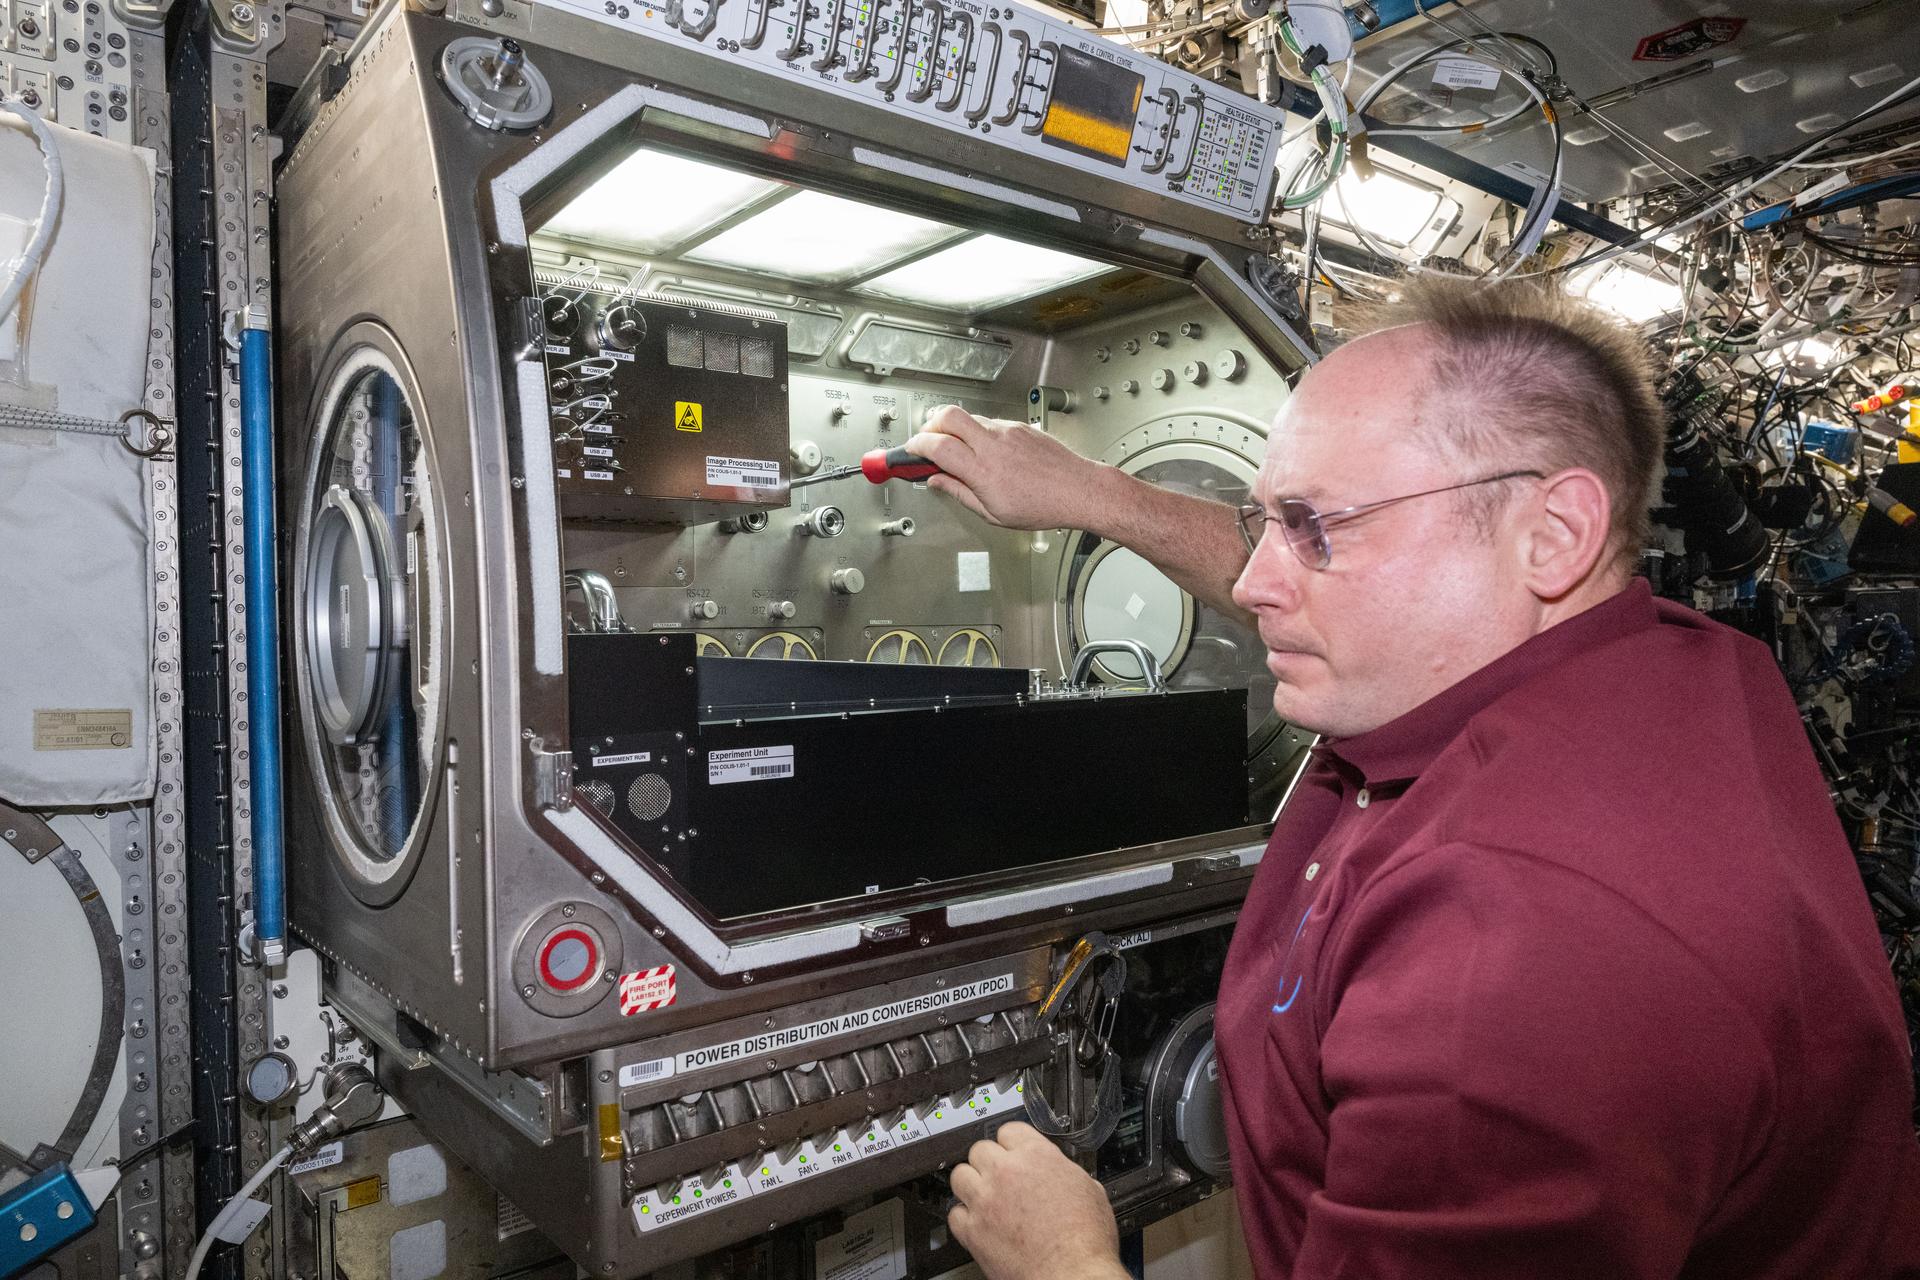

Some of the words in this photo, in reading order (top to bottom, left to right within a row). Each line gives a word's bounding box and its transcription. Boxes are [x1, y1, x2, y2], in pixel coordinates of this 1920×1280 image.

[458, 13, 480, 25] UNLOCK
[503, 12, 517, 21] LOCK
[21, 43, 40, 53] Down
[1079, 42, 1089, 51] INFO
[1096, 48, 1115, 60] CONTROL
[1117, 56, 1133, 69] CENTRE
[786, 62, 801, 71] OUTLET
[820, 73, 834, 82] OUTLET
[1245, 115, 1261, 126] STATUS
[707, 457, 727, 467] Image
[728, 459, 763, 470] Processing
[597, 756, 633, 764] EXPERIMENT
[710, 750, 752, 762] Experiment
[753, 748, 769, 757] Unit
[630, 985, 646, 993] FIRE
[648, 980, 667, 990] PORT
[685, 1043, 740, 1068] POWER
[744, 1020, 839, 1055] DISTRIBUTION
[842, 1012, 869, 1031] AND
[872, 991, 950, 1023] CONVERSION
[953, 984, 977, 1001] BOX
[978, 976, 1009, 996] (PDC)
[975, 1107, 988, 1117] CMP
[864, 1139, 891, 1154] AIRLOCK
[832, 1154, 847, 1165] FAN
[847, 1151, 853, 1160] R
[798, 1166, 813, 1177] FAN
[813, 1163, 820, 1172] C
[761, 1178, 776, 1189] FAN
[776, 1175, 783, 1184] L
[635, 1195, 648, 1205] +5V
[655, 1200, 705, 1224] EXPERIMENT
[705, 1190, 737, 1207] POWERS
